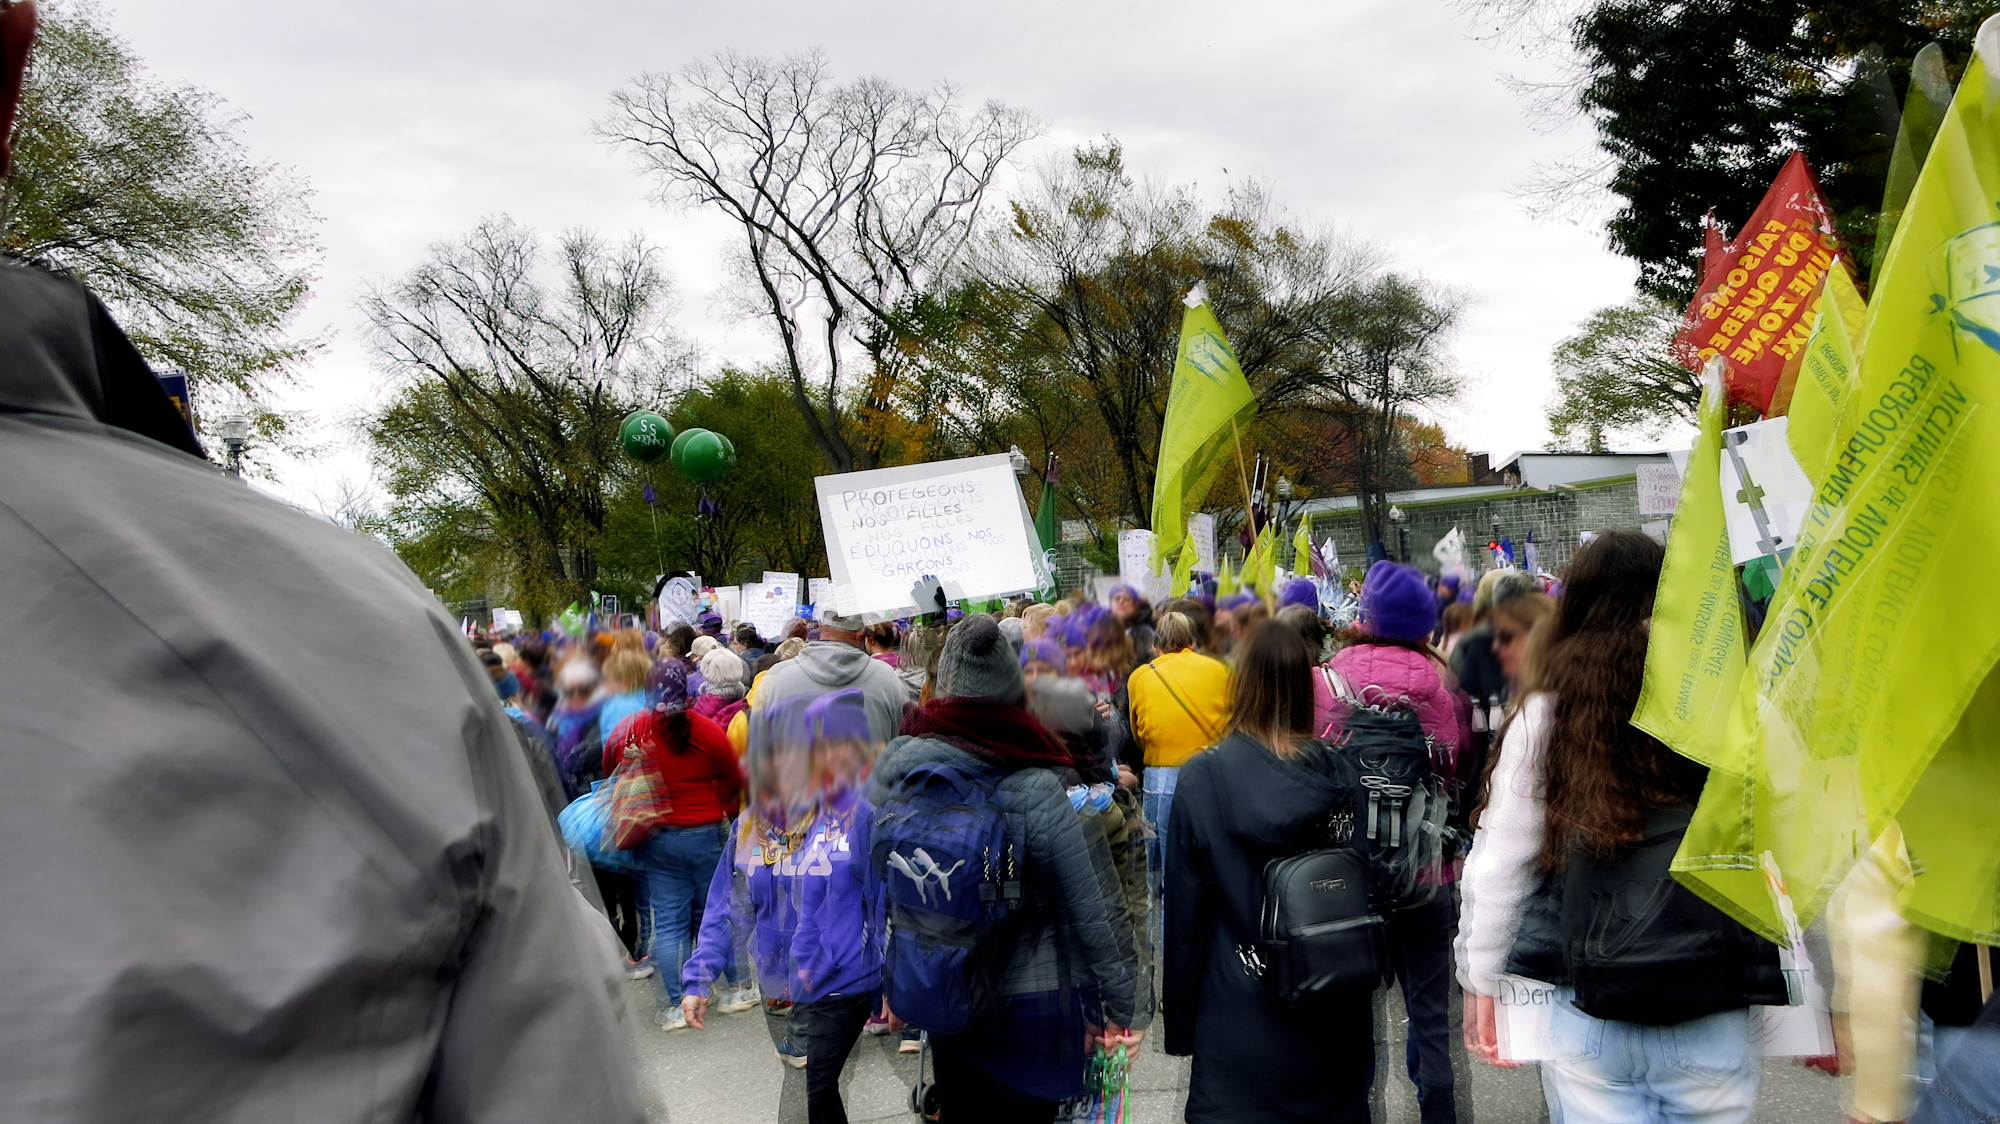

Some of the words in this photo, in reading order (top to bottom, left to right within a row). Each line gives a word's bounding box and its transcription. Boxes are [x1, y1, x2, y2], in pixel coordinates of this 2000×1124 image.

[851, 514, 888, 530] NOS
[907, 503, 963, 521] FILLES
[851, 532, 954, 560] ÉDUQUONS
[968, 528, 993, 541] NOS
